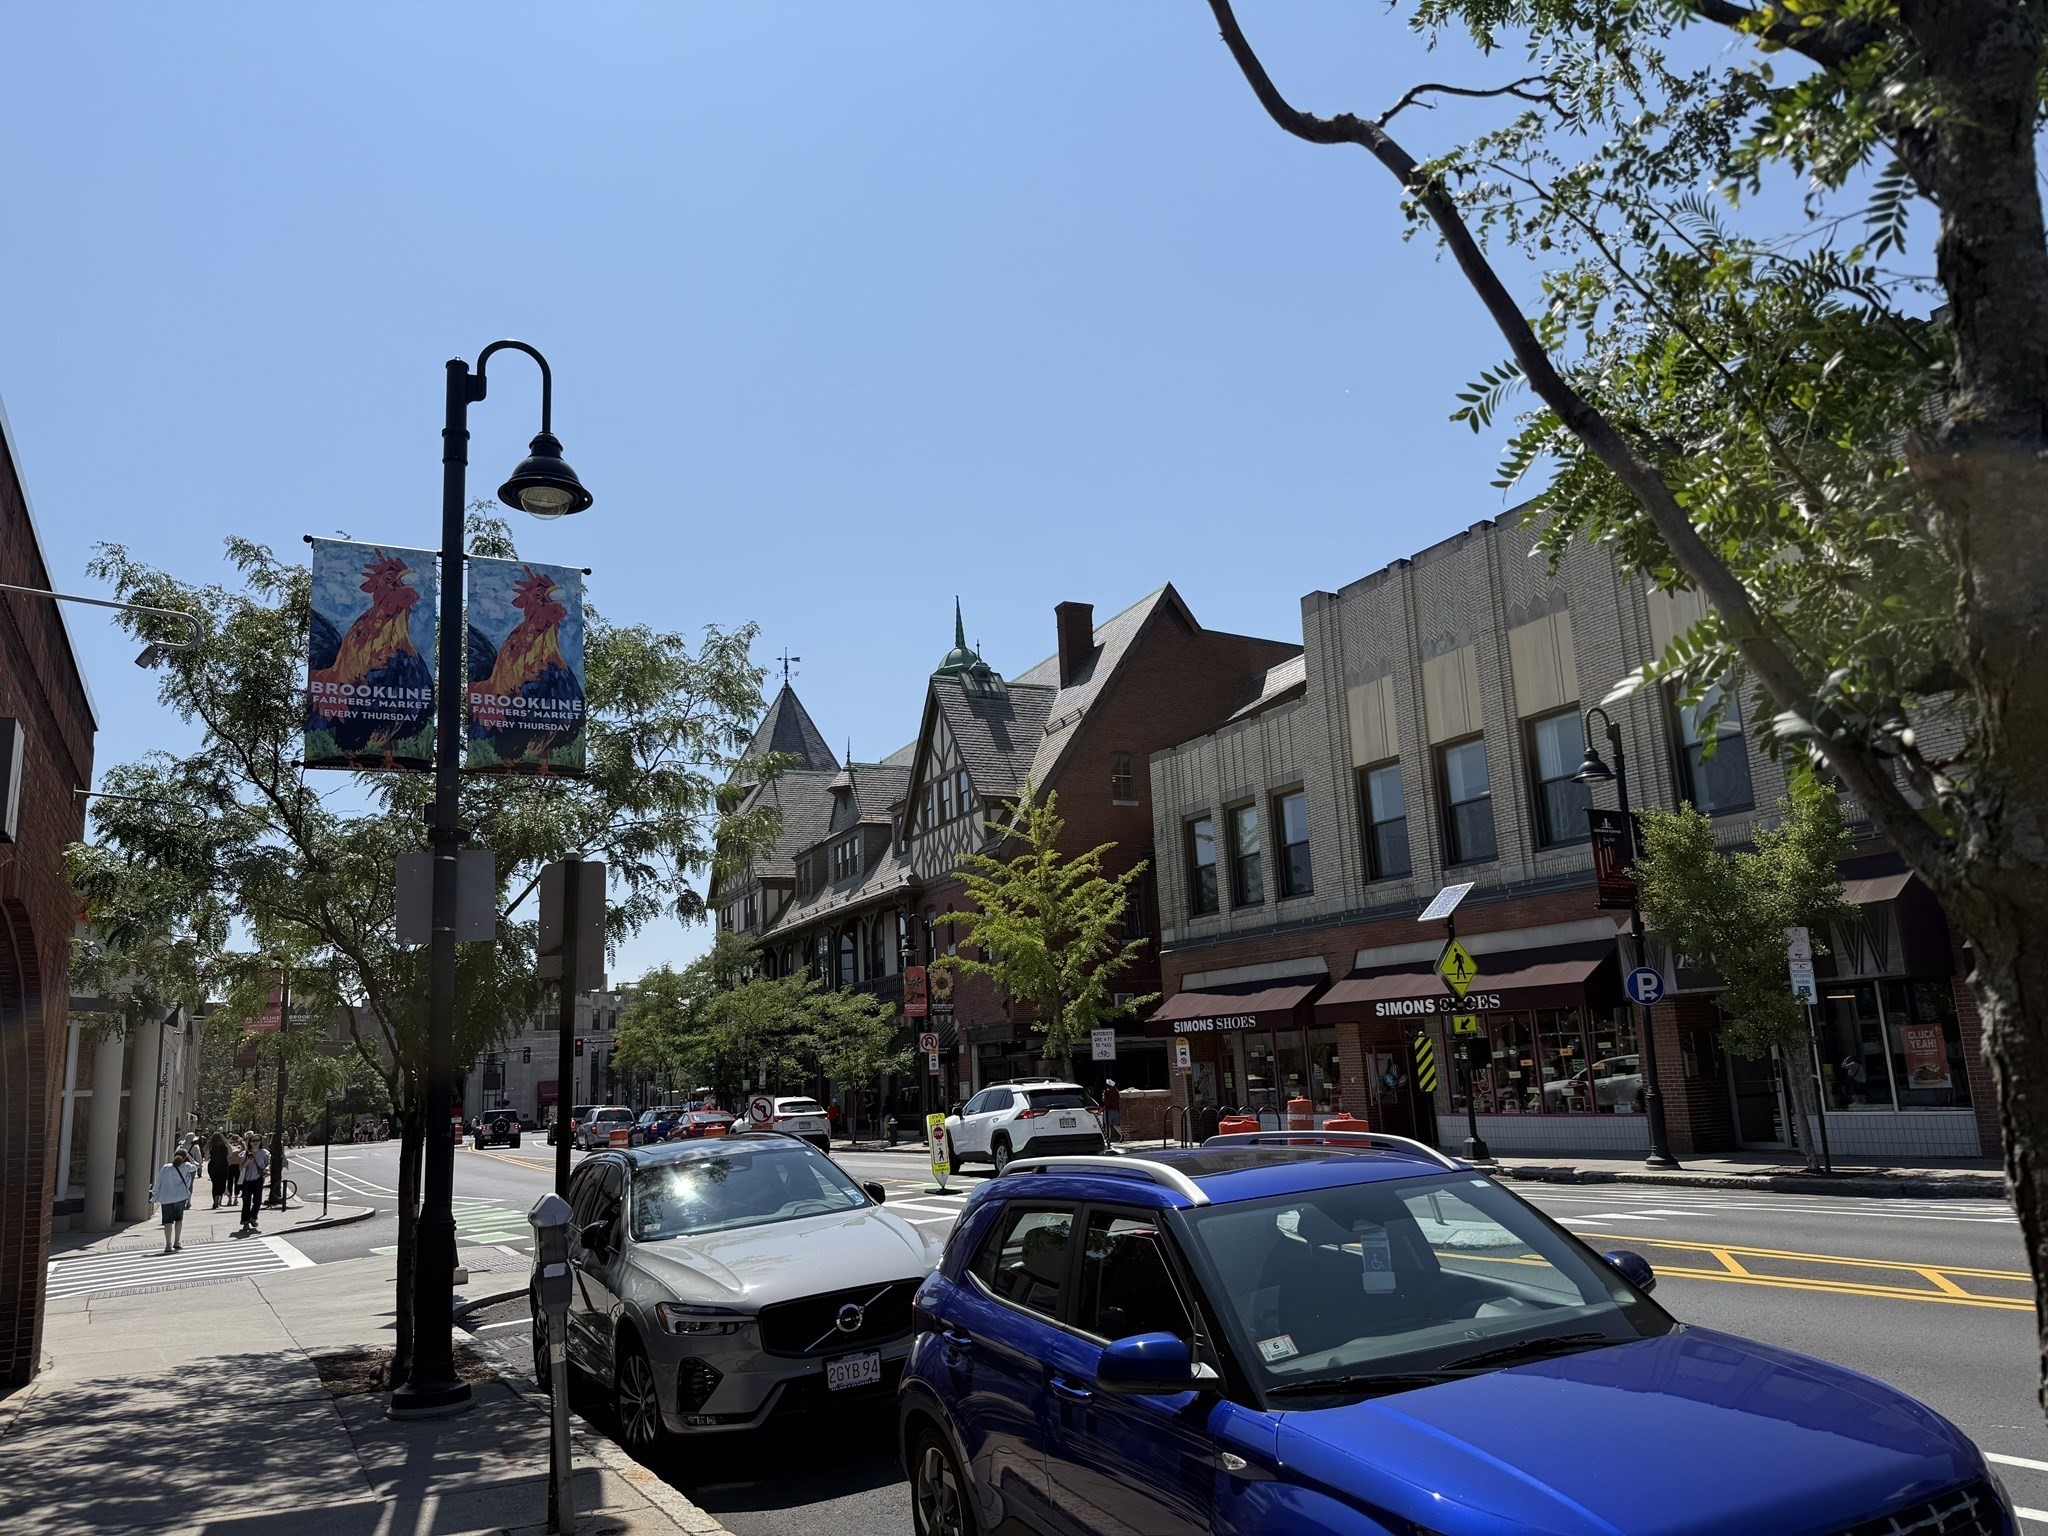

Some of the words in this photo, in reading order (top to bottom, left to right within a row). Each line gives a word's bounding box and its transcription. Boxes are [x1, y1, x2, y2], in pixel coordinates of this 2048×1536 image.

[310, 681, 432, 701] BROOKLINE
[312, 695, 377, 707] FARMERS'
[379, 701, 430, 709] MARKET
[470, 692, 583, 711] BROOKLINE
[324, 709, 359, 719] EVERY
[362, 711, 419, 722] THURSDAY
[472, 706, 531, 717] FARMERS'
[533, 711, 580, 720] MARKET
[483, 719, 516, 729] EVERY
[518, 721, 571, 732] THURSDAY
[1636, 972, 1658, 1001] P
[1375, 998, 1436, 1017] SIMONS
[1173, 1018, 1214, 1033] SIMONS
[1215, 1015, 1257, 1030] SHOES
[1908, 1030, 1936, 1040] CLUCK
[1910, 1038, 1938, 1049] YEAH!
[1272, 1342, 1280, 1350] 6
[828, 1362, 860, 1384] 2GYB
[862, 1358, 878, 1377] 94
